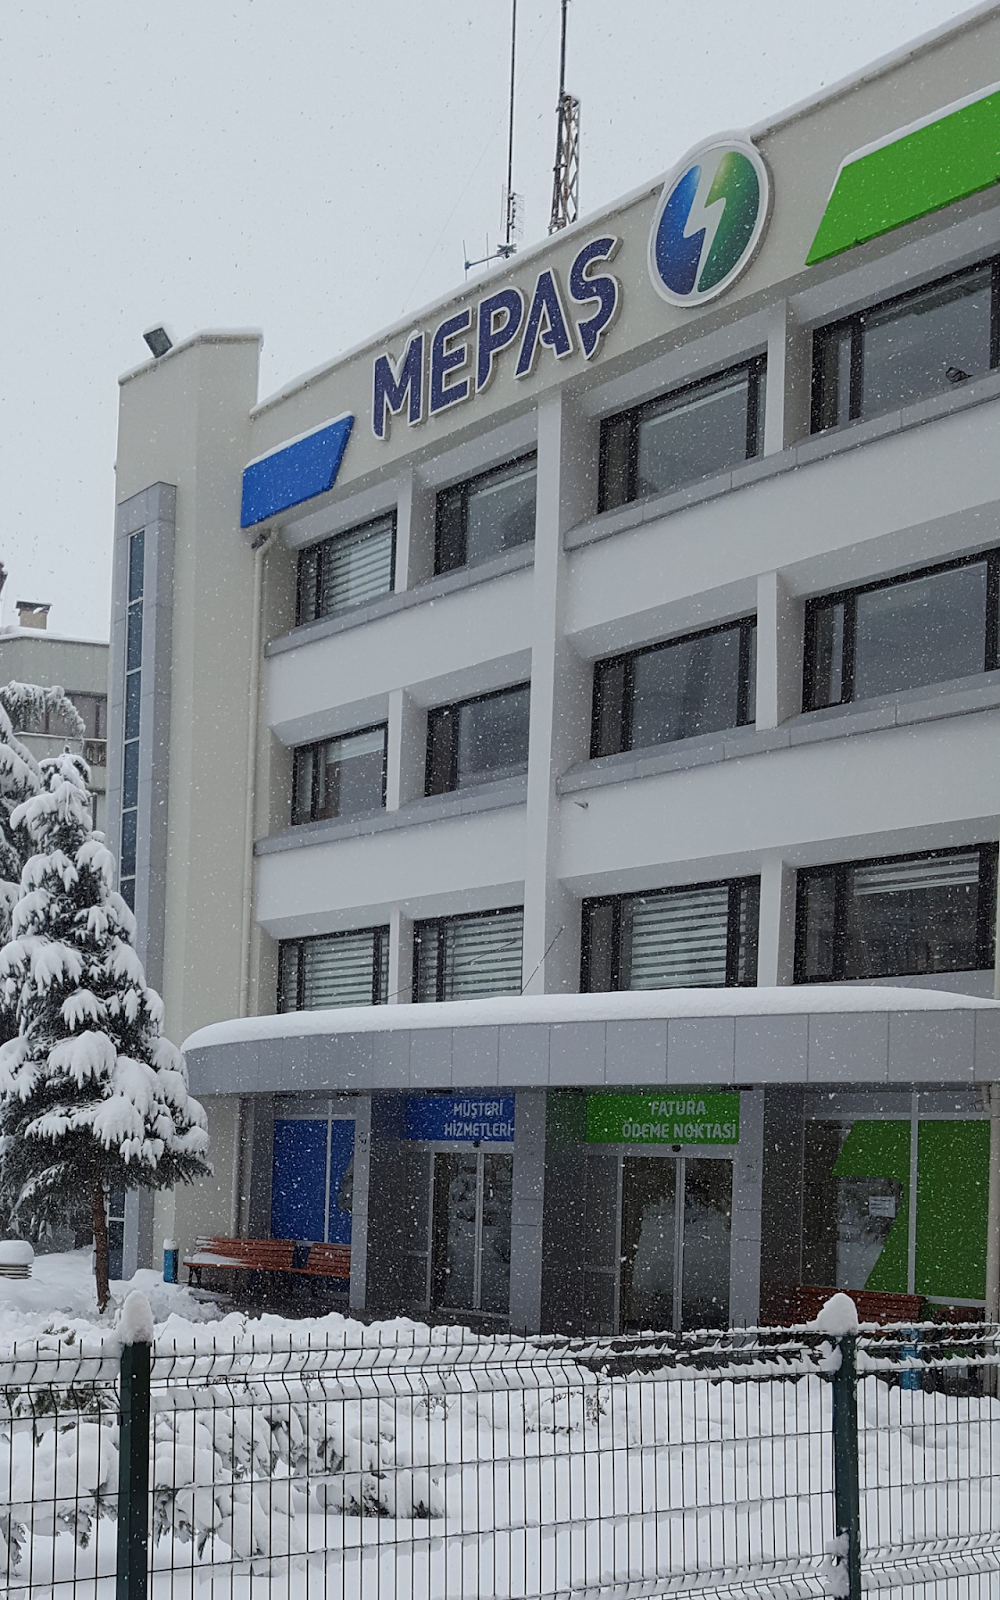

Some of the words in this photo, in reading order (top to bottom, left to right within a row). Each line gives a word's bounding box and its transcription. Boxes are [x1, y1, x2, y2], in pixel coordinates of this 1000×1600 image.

[372, 235, 622, 440] MEPAŞ
[453, 1100, 504, 1118] MÜŞTERİ
[651, 1101, 706, 1116] FATURA
[444, 1120, 511, 1137] HİZMETLERİ
[673, 1123, 736, 1138] NOKTASI
